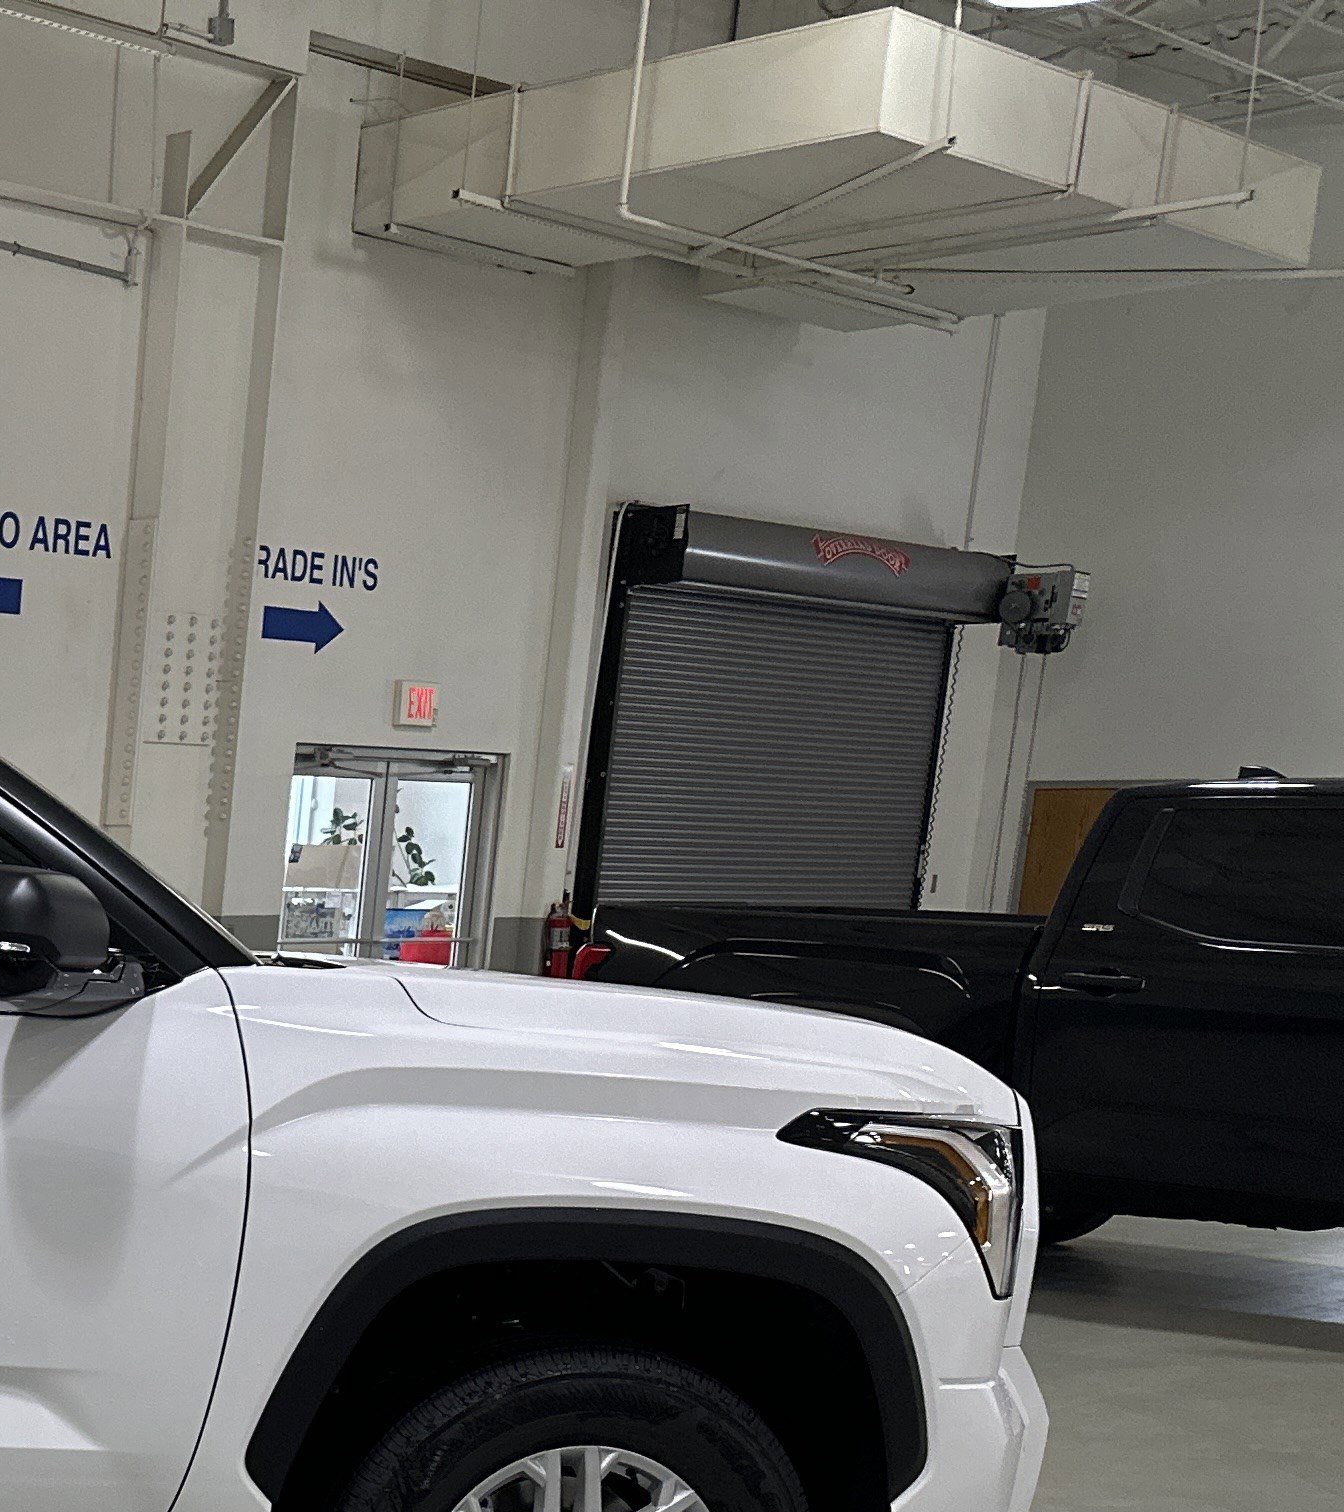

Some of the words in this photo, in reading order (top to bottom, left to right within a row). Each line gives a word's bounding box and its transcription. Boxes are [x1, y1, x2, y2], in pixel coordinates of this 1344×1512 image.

[28, 515, 112, 560] AREA
[257, 544, 326, 586] RADE
[331, 554, 379, 592] IN'S
[406, 686, 436, 721] EXIT
